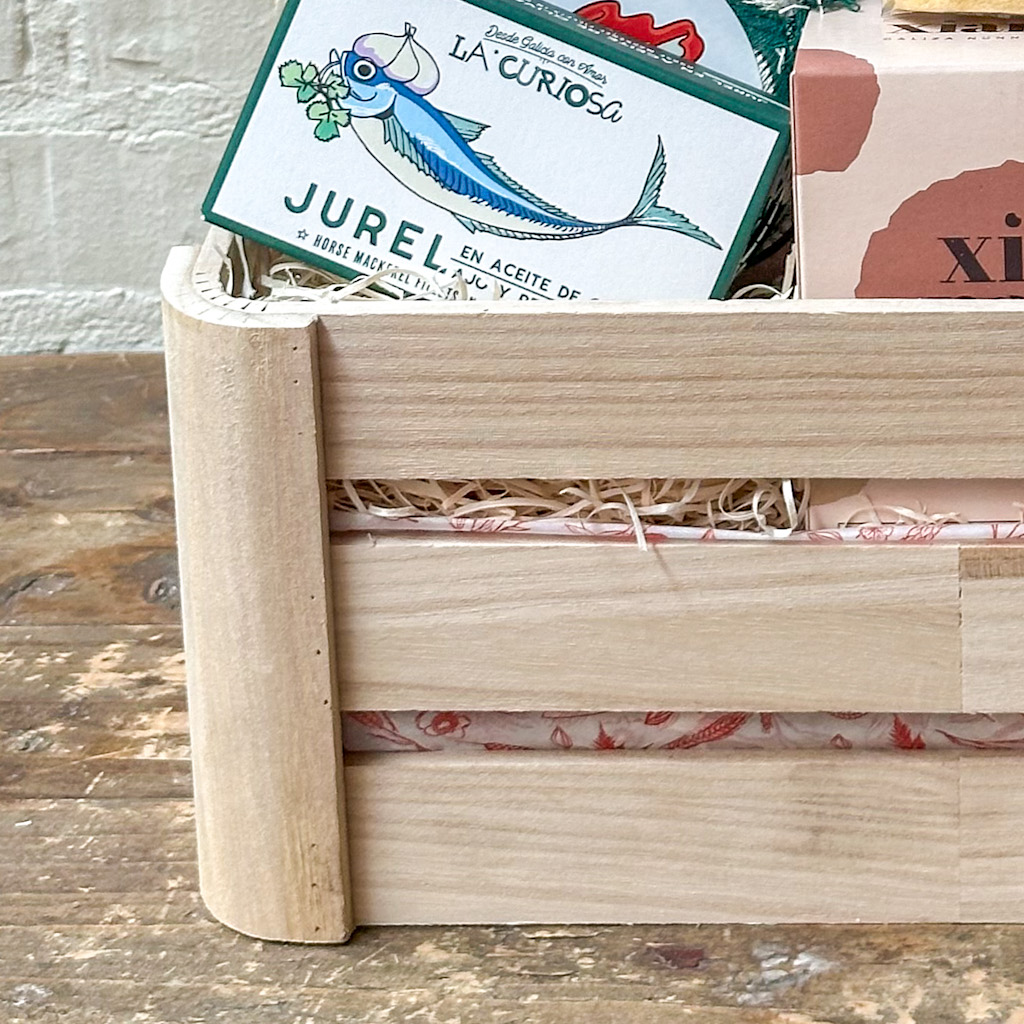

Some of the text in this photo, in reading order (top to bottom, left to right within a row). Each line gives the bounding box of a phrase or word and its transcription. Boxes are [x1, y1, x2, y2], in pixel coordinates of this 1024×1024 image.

[448, 34, 489, 72] LA
[484, 23, 520, 44] Desde
[557, 52, 576, 68] con
[577, 61, 608, 85] Amor
[283, 182, 447, 275] JUREL
[312, 233, 352, 261] HORSE
[460, 244, 485, 264] EN
[490, 258, 552, 292] ACEITE
